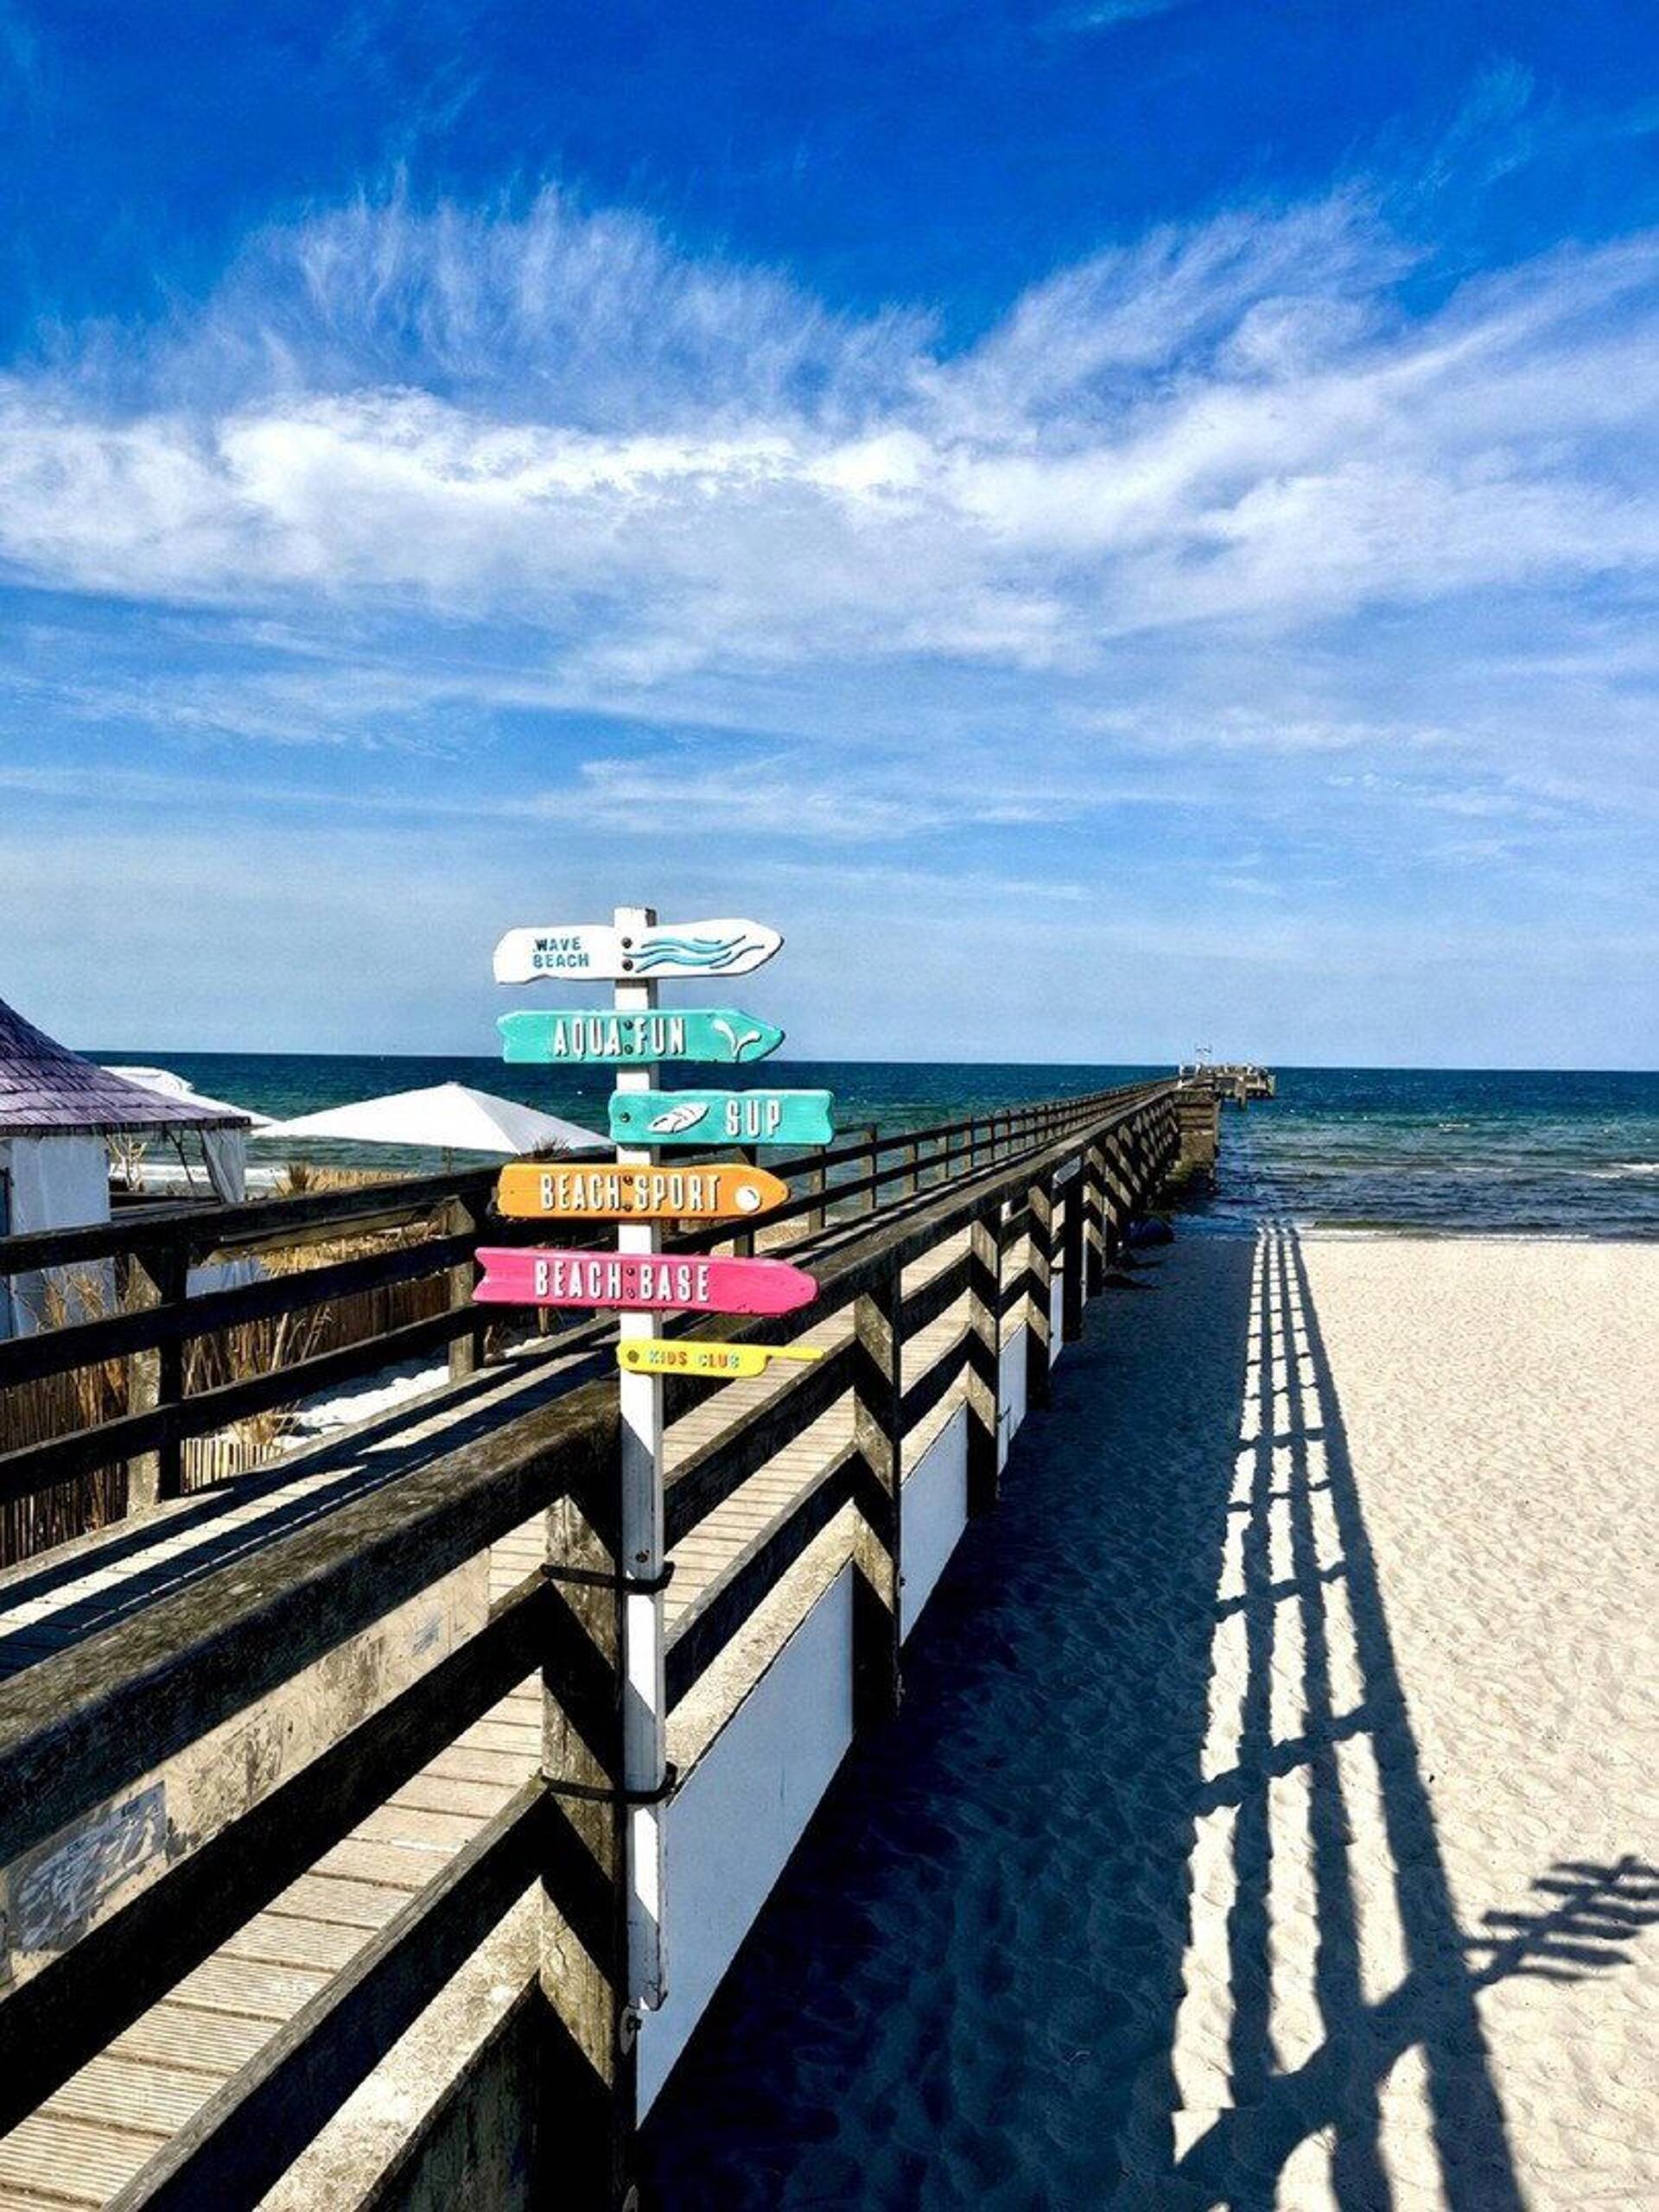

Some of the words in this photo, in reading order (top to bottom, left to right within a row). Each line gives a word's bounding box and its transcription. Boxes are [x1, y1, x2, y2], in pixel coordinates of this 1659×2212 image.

[533, 937, 582, 952] WAVE
[533, 954, 589, 969] BEACH
[554, 1018, 624, 1060] AQUA
[635, 1018, 687, 1056] FUN
[725, 1101, 781, 1138] SUP
[540, 1173, 622, 1211] BEACH
[634, 1175, 721, 1211] SPORT
[535, 1259, 622, 1300] BEACH
[639, 1265, 710, 1302] BASE
[648, 1350, 688, 1367] KIDS
[697, 1352, 741, 1370] CLUB
